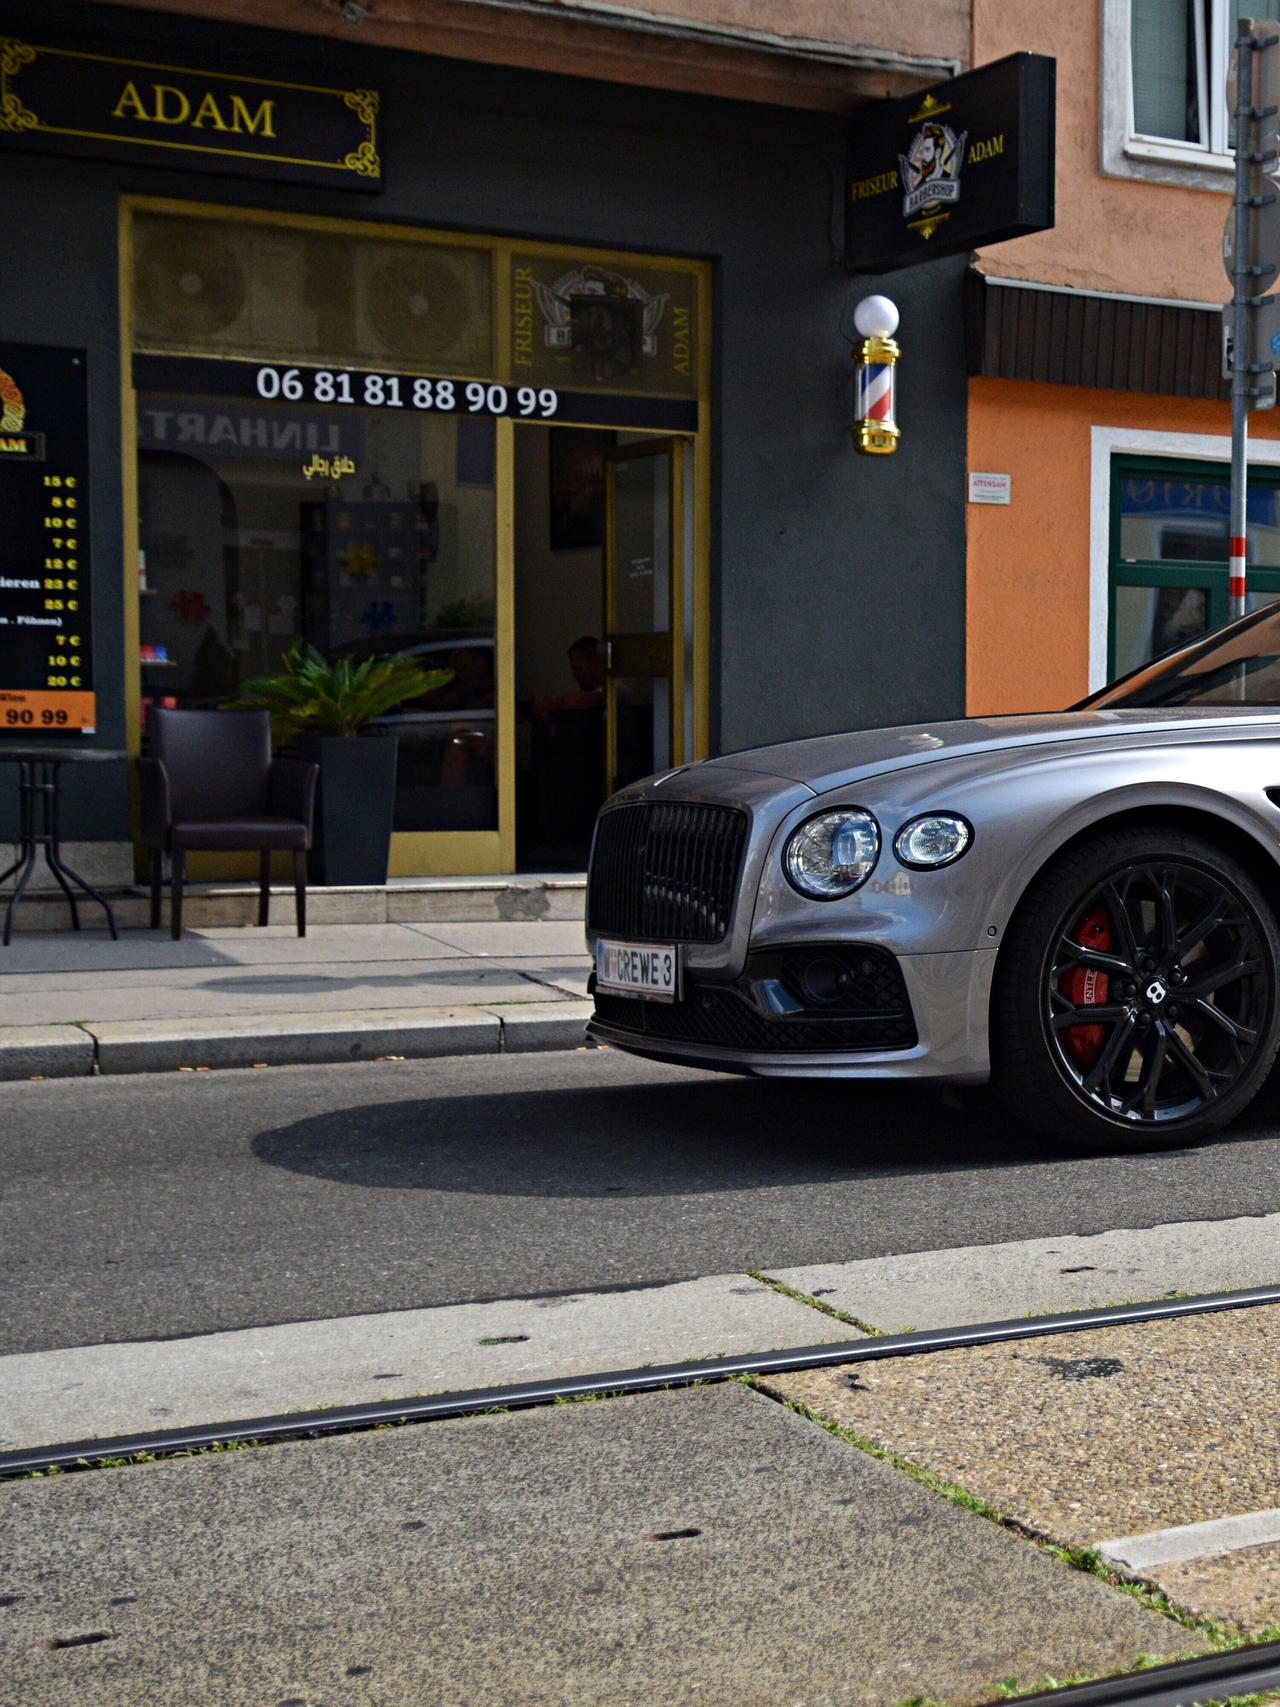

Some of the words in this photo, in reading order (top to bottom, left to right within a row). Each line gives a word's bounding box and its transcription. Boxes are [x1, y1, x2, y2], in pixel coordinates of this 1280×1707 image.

[111, 80, 277, 138] ADAM
[967, 134, 1004, 164] ADAM
[851, 170, 898, 200] FRISEUR
[515, 266, 534, 366] FRISEUR
[673, 306, 691, 376] ADAM
[257, 367, 304, 400] 06
[314, 371, 354, 403] 81
[364, 375, 404, 407] 81
[412, 378, 456, 410] 88
[465, 382, 508, 414] 90
[517, 387, 558, 417] 99
[6, 708, 34, 725] 90
[41, 709, 68, 725] 99
[617, 949, 660, 985] CREWE
[663, 954, 672, 986] 3
[1086, 969, 1096, 1004] ENTLE
